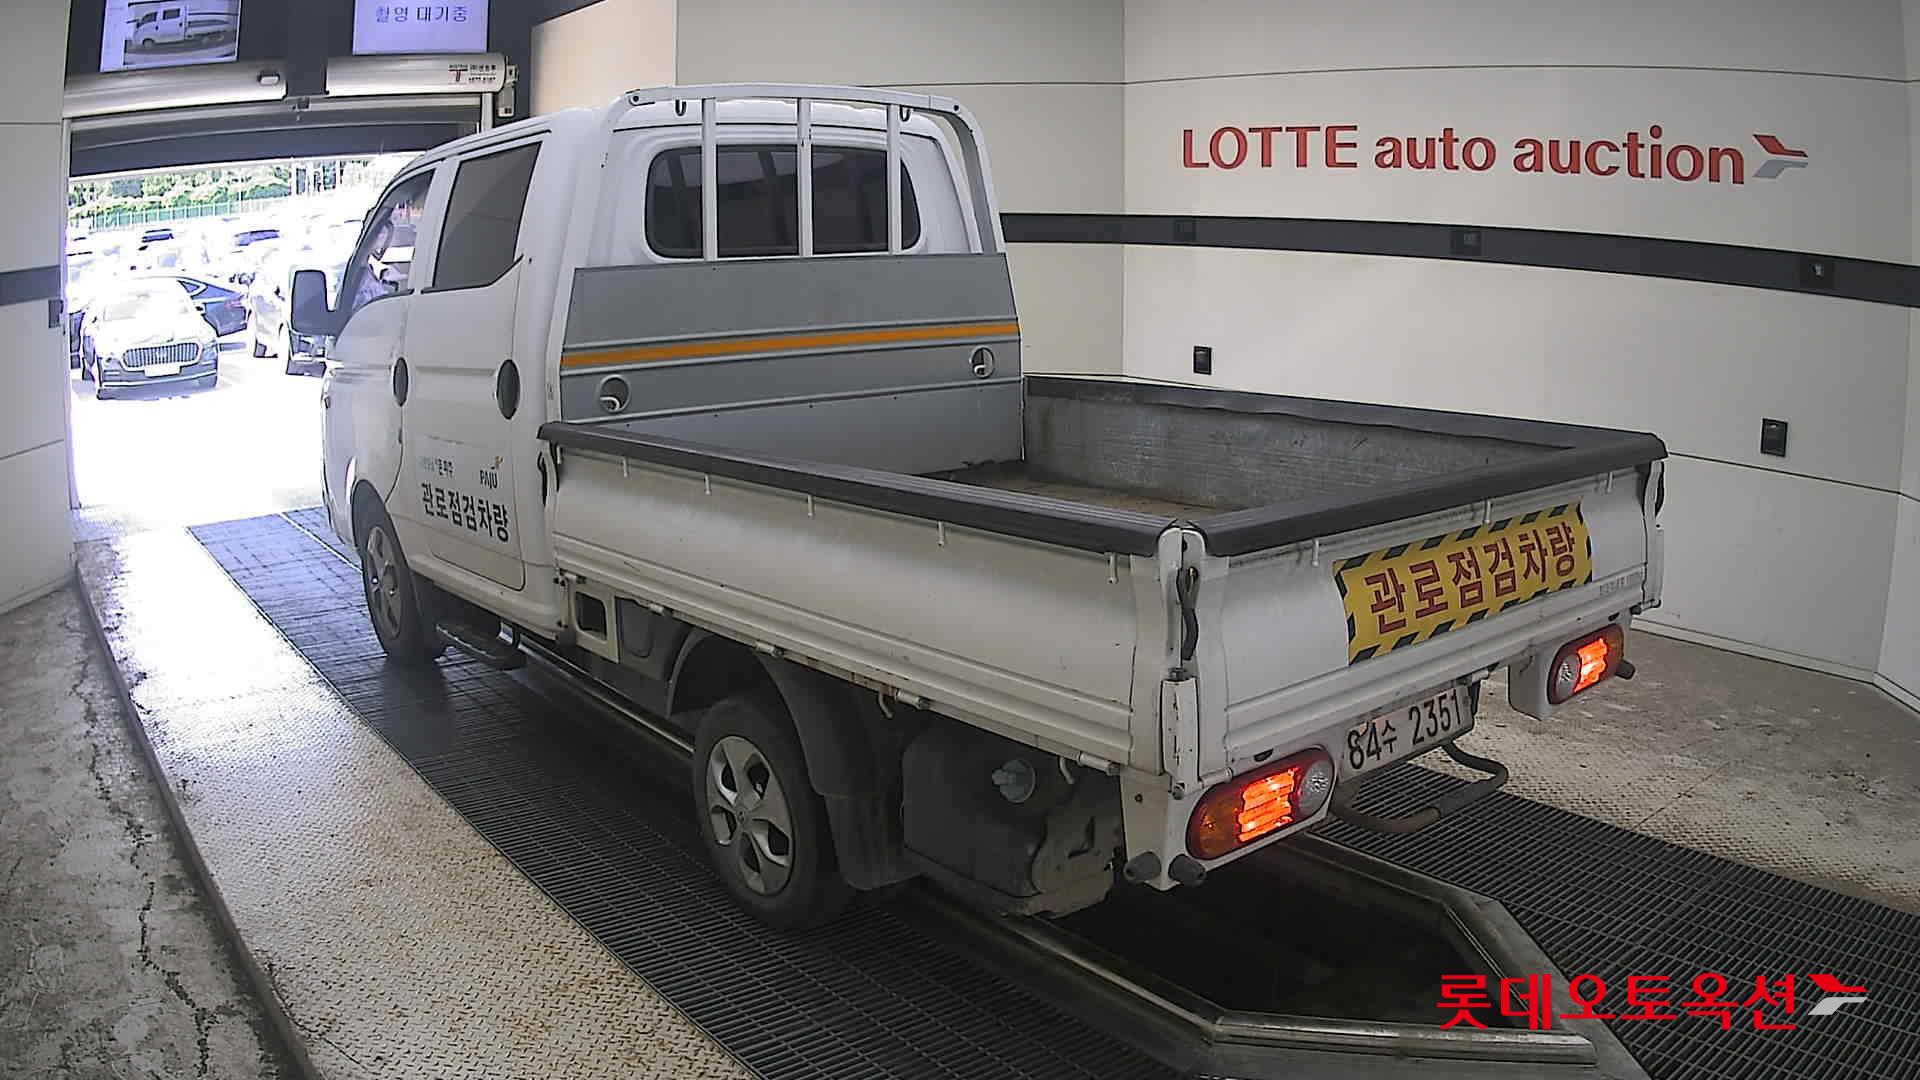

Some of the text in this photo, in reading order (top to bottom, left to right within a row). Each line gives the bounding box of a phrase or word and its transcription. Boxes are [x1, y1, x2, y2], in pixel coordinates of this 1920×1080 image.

[416, 5, 468, 23] 대기중
[1183, 125, 1745, 185] LOTTE auto auction
[421, 481, 509, 543] 관로점검차량
[1364, 520, 1577, 635] 관로점검차량
[1347, 688, 1461, 770] 84수 2351
